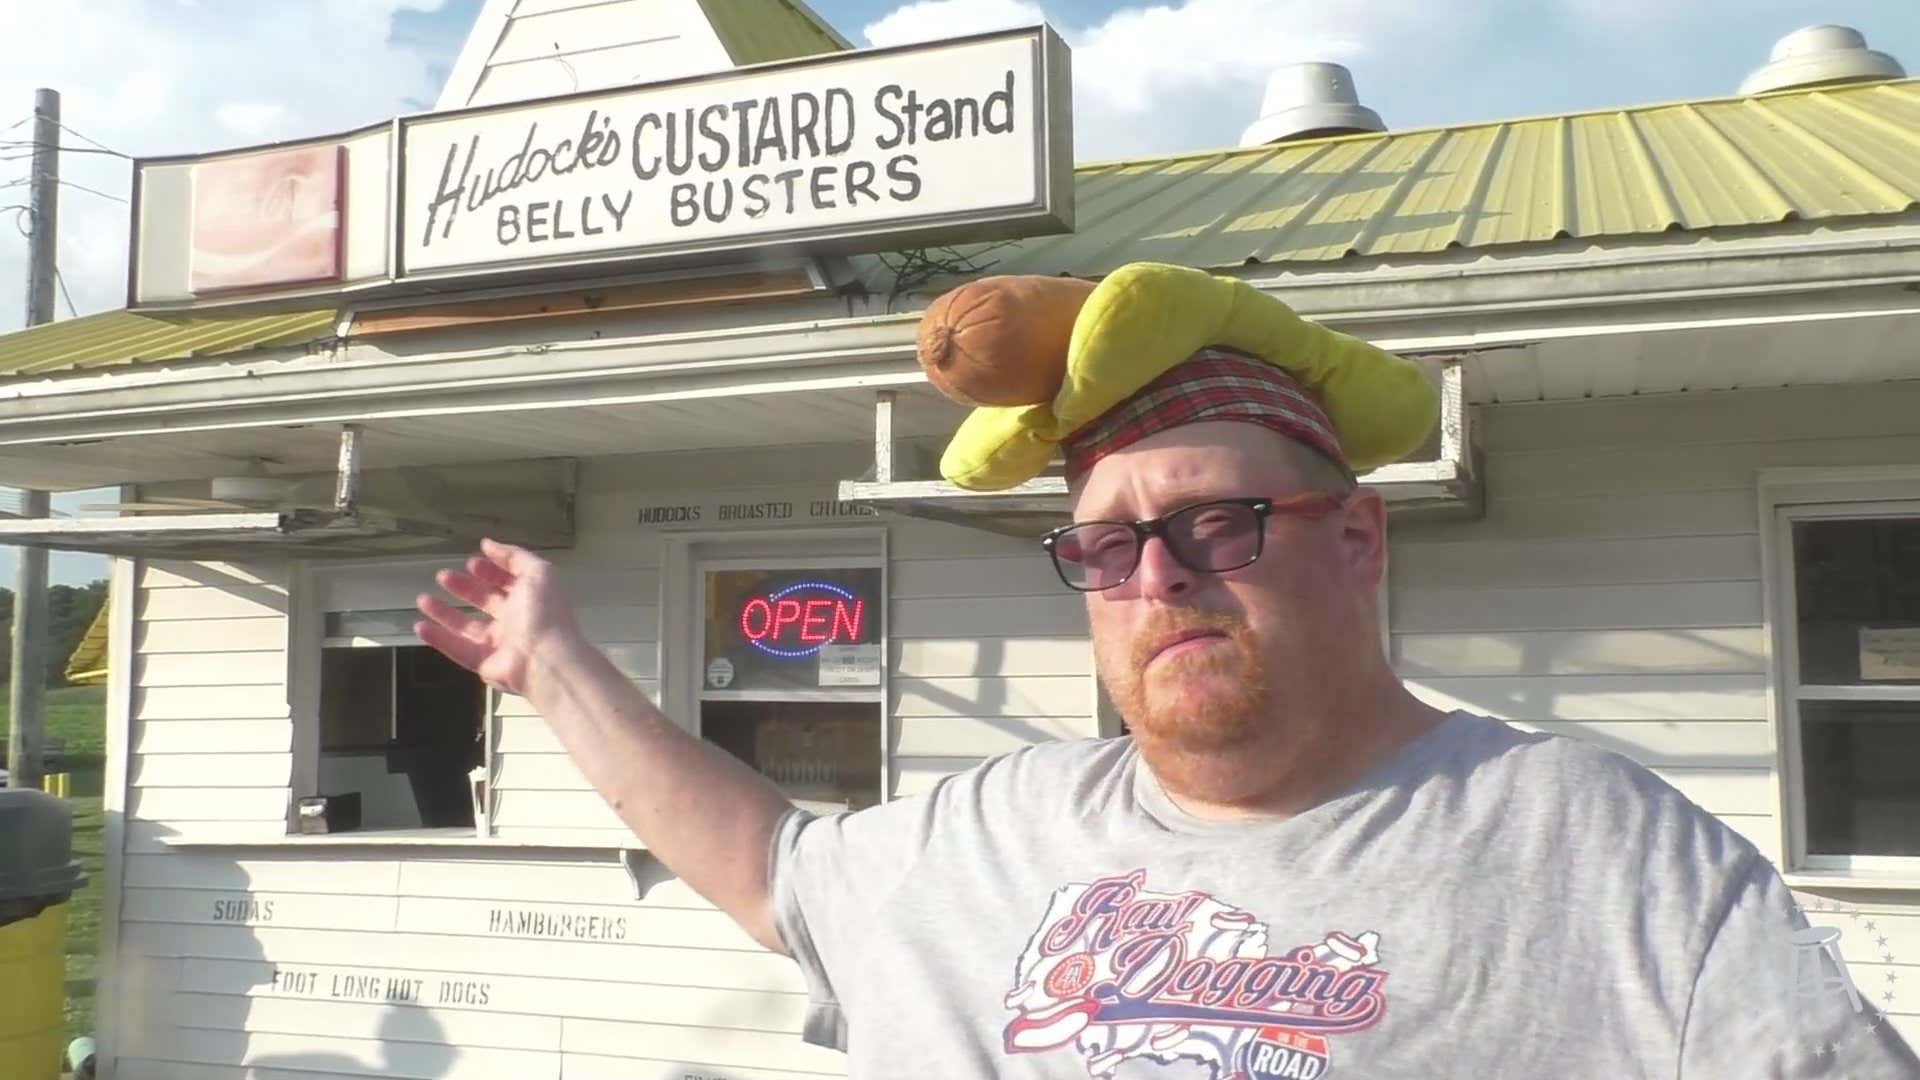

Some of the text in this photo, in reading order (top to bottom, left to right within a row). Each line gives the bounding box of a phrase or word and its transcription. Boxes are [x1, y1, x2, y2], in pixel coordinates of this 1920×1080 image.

[423, 109, 621, 247] Hudock's
[631, 88, 855, 180] CUSTARD
[873, 70, 1016, 147] Stand
[496, 154, 922, 246] BELLY BUSTERS
[638, 506, 701, 525] HUDOCKS
[718, 502, 793, 521] BROASTED
[740, 599, 864, 640] OPEN
[212, 900, 275, 921] SODAS
[488, 909, 627, 940] HAMBURGERS
[1041, 869, 1206, 953] Raw
[271, 970, 491, 1005] FOOT LONG HOT DOGS
[1098, 933, 1388, 1022] Dogging
[1253, 1044, 1320, 1080] ROAD
